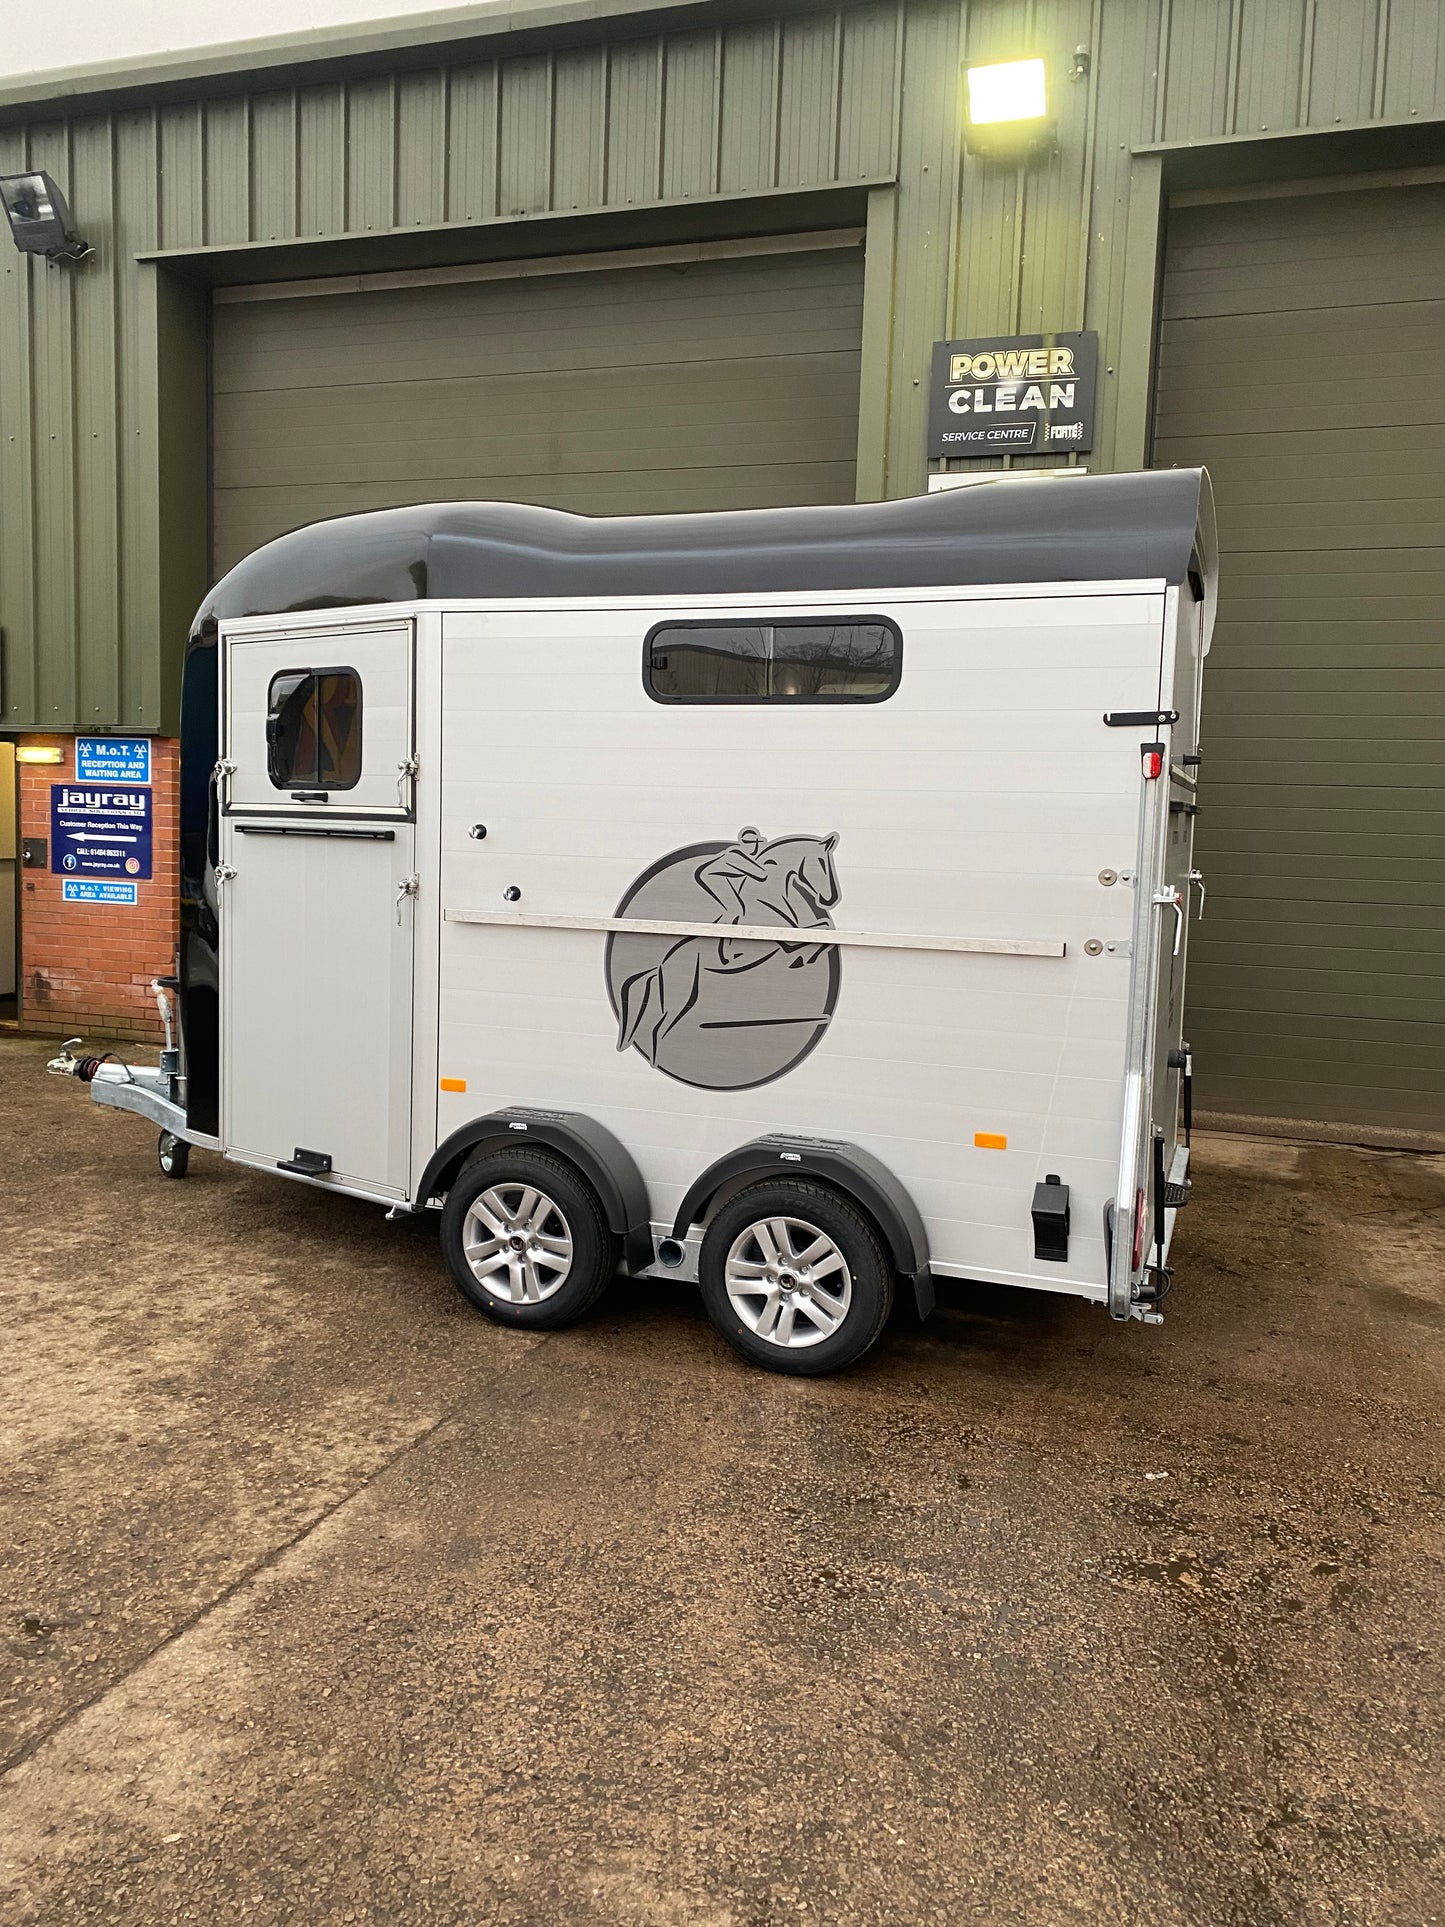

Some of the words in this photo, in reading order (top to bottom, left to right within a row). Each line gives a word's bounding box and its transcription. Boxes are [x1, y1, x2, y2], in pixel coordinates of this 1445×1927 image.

[950, 347, 1075, 382] POWER
[948, 383, 1075, 414] CLEAN
[942, 431, 985, 442] SERVICE
[987, 429, 1029, 439] CENTRE
[96, 744, 130, 756] M.o.T.
[81, 760, 126, 769] RECEPTION
[128, 761, 145, 769] AND
[84, 769, 118, 777] WAITING
[120, 770, 142, 778] AREA
[57, 788, 145, 810] jayray
[59, 820, 86, 828] Customer
[87, 821, 116, 830] Reception
[116, 822, 129, 830] This
[129, 823, 143, 832] Way
[80, 884, 100, 892] M.o.T.
[102, 885, 133, 893] VIEWING
[99, 892, 133, 900] AVAILABLE
